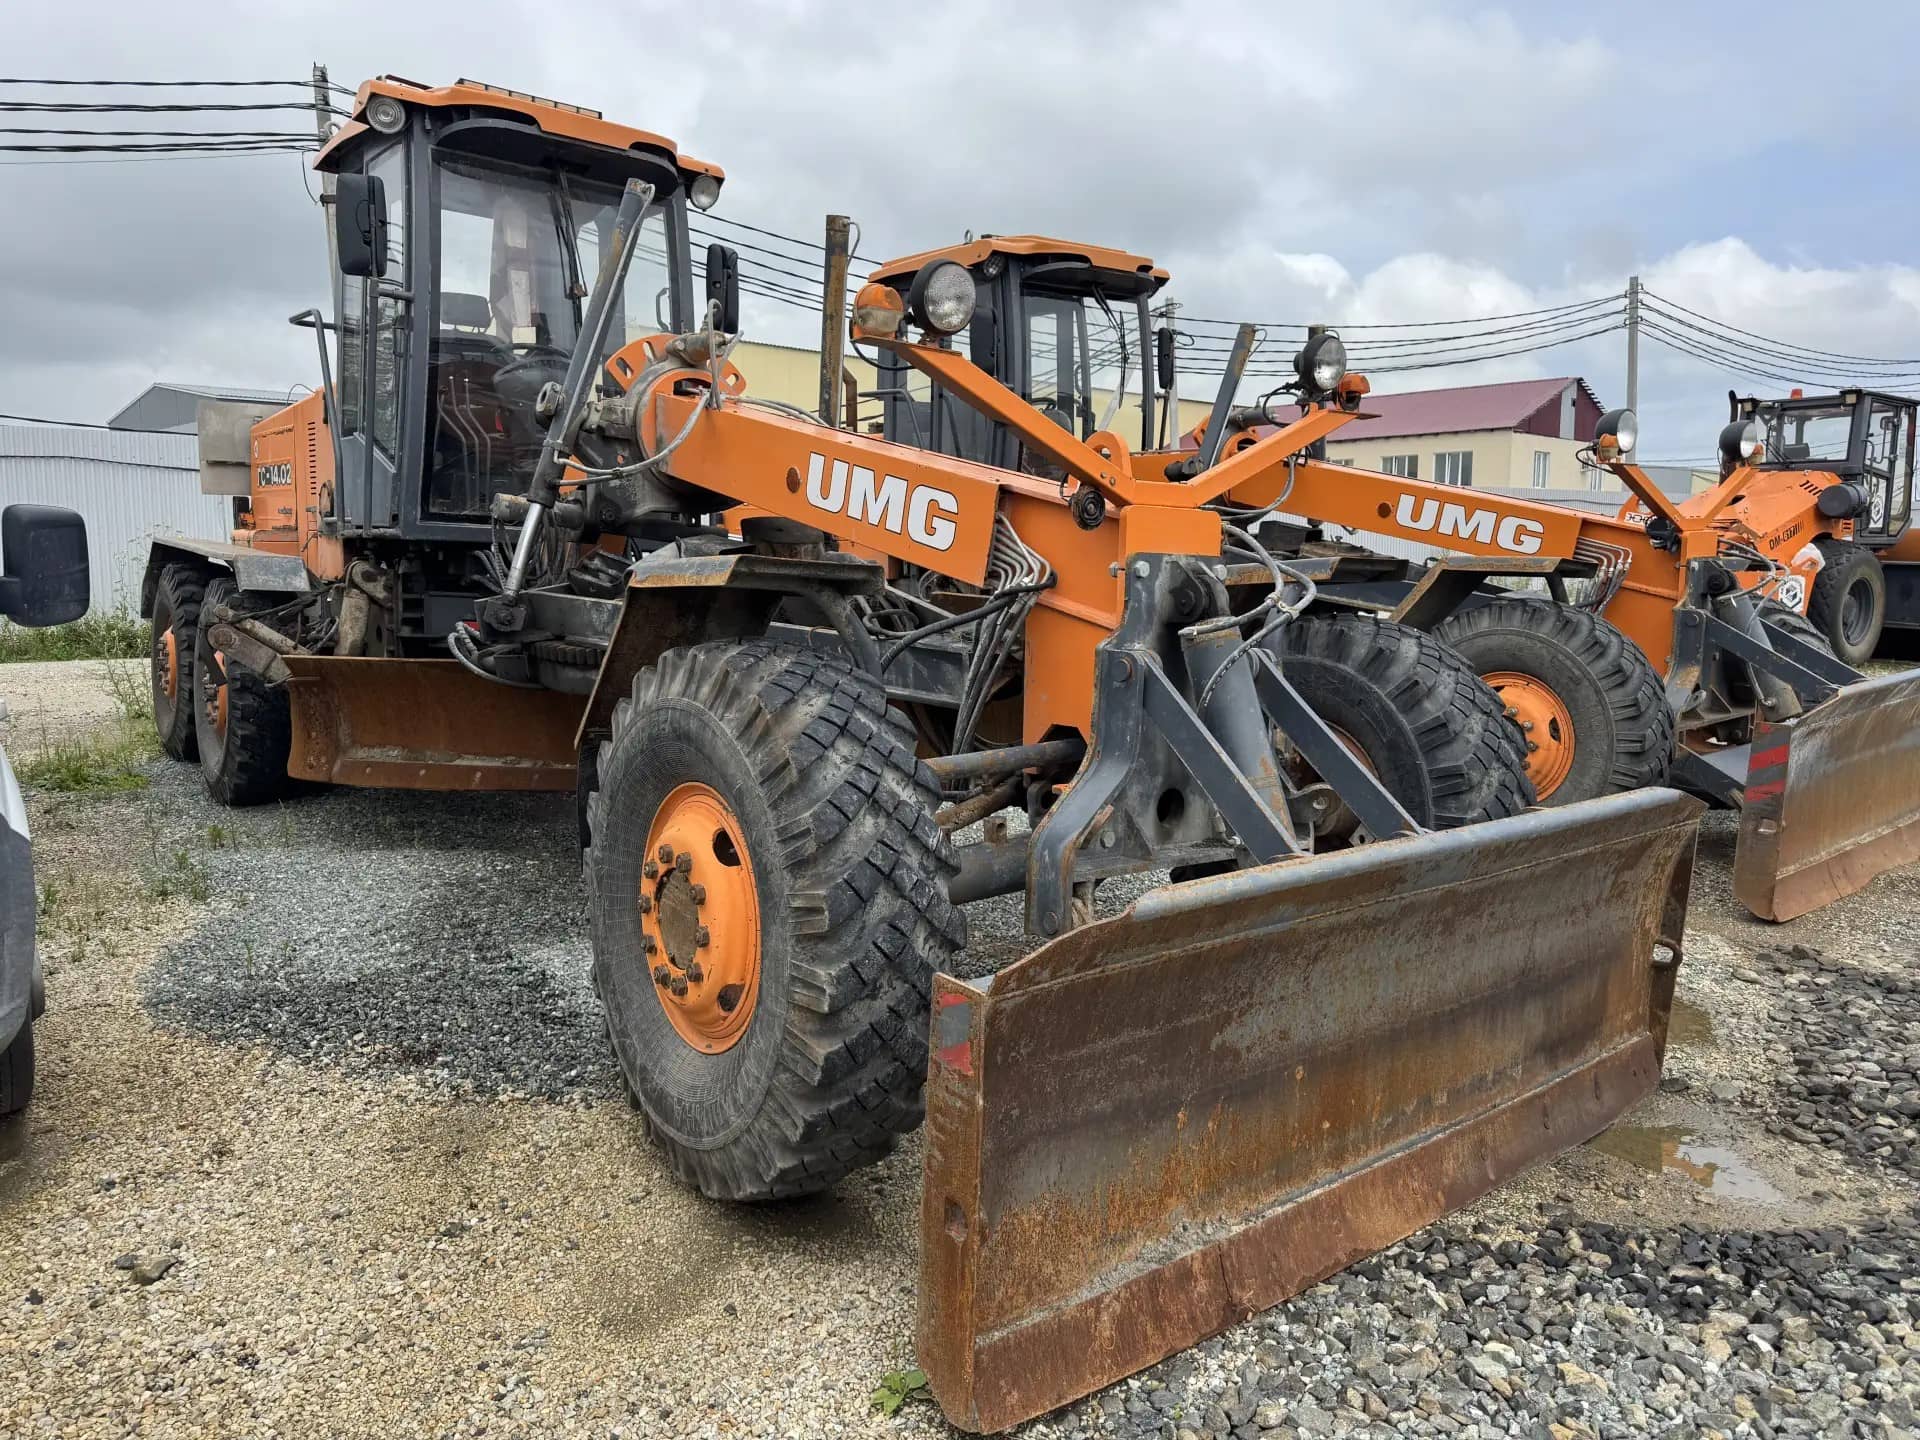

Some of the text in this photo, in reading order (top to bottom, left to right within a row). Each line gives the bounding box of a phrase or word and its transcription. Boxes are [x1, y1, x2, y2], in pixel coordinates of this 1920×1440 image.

[257, 463, 292, 487] ГС-14.02
[806, 451, 959, 552] UMG
[1395, 493, 1545, 555] UMG
